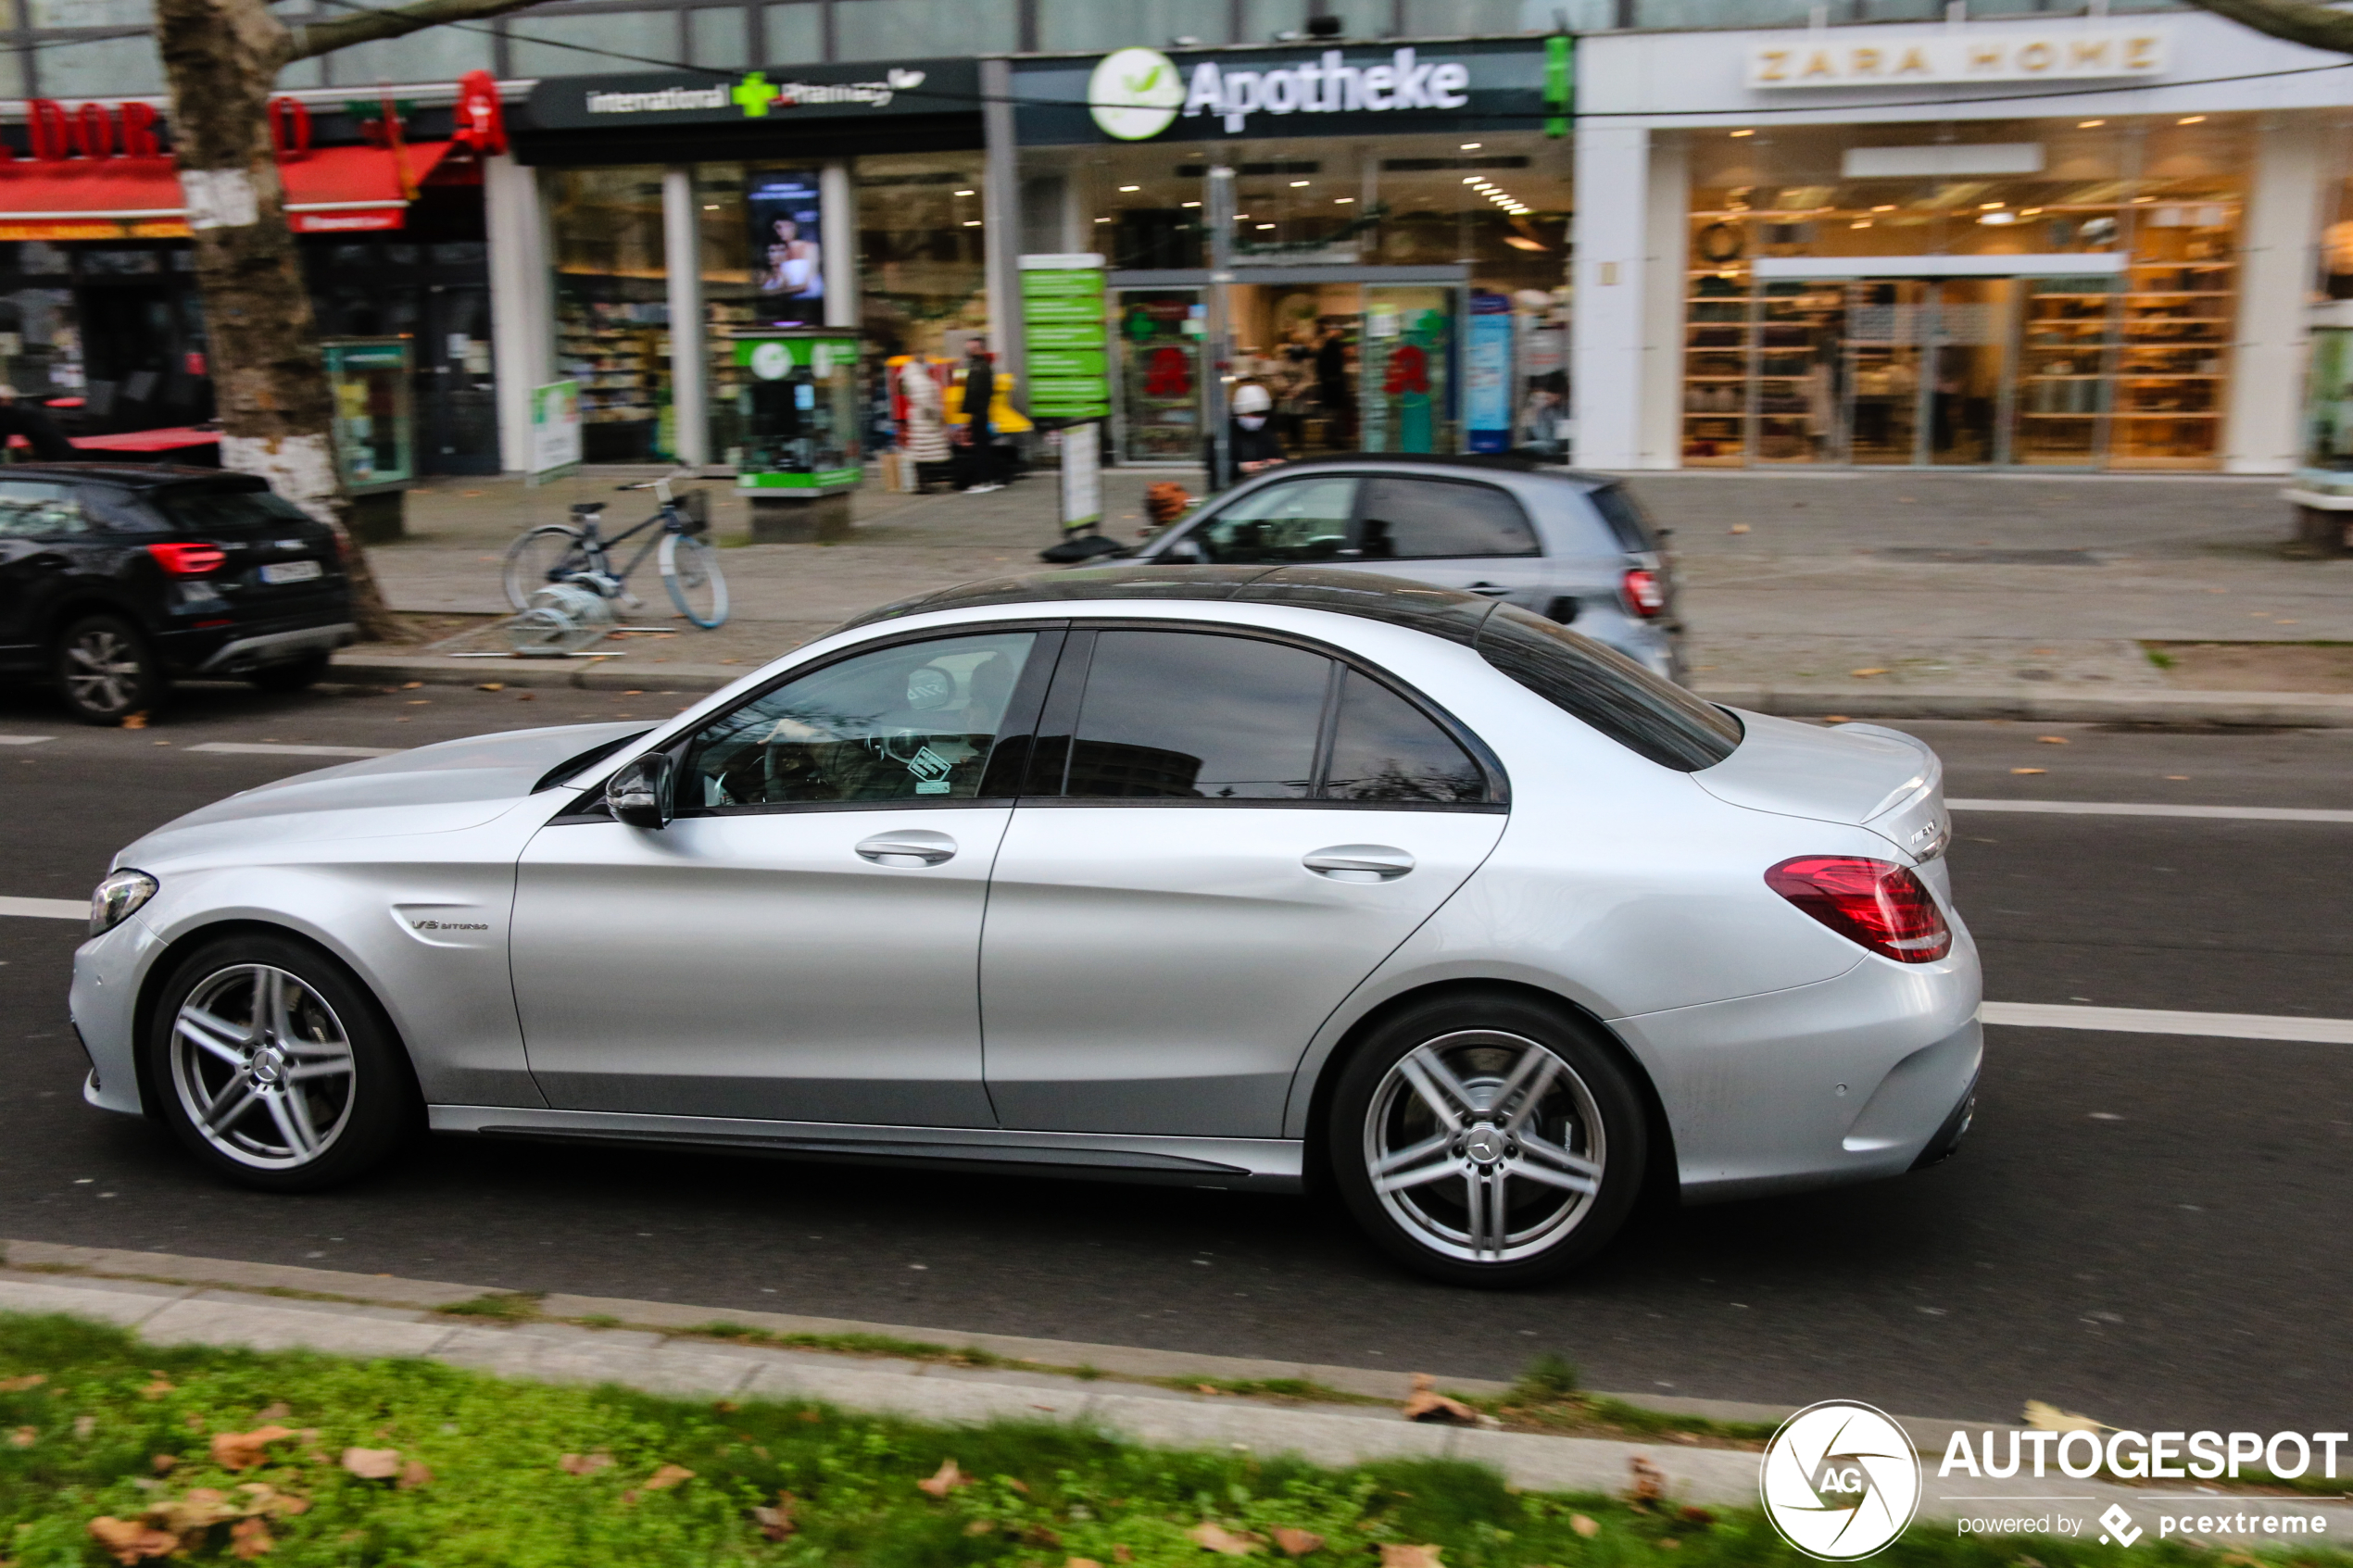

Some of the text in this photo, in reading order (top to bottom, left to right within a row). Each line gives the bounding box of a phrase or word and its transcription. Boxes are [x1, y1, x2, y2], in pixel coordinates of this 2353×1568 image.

[1758, 36, 2158, 82] ZARA HOME
[1182, 47, 1469, 133] Apotheke
[411, 920, 439, 930] V8
